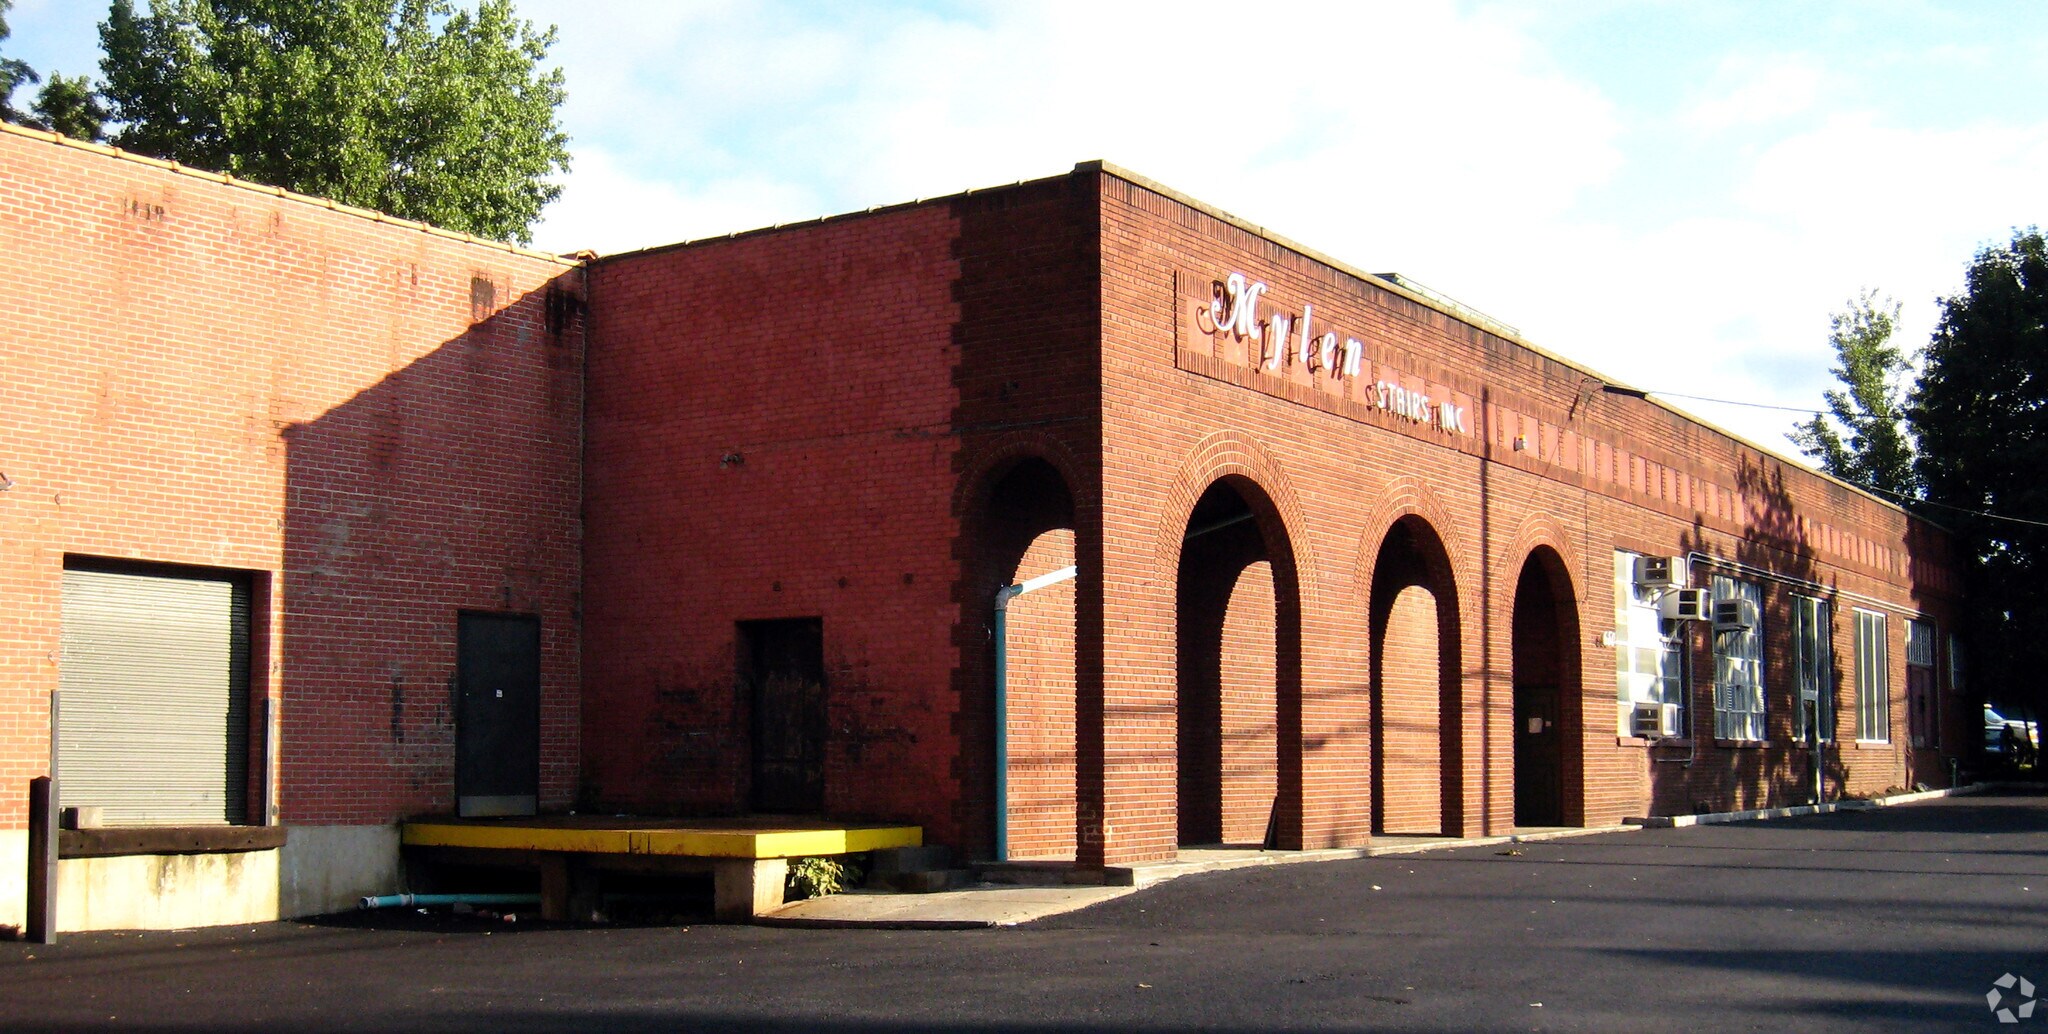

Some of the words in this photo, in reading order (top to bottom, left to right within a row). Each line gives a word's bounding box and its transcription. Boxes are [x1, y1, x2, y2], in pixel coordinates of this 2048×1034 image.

[1210, 272, 1363, 377] Mylen
[1376, 380, 1429, 423] STAIRS
[1440, 401, 1465, 433] INC
